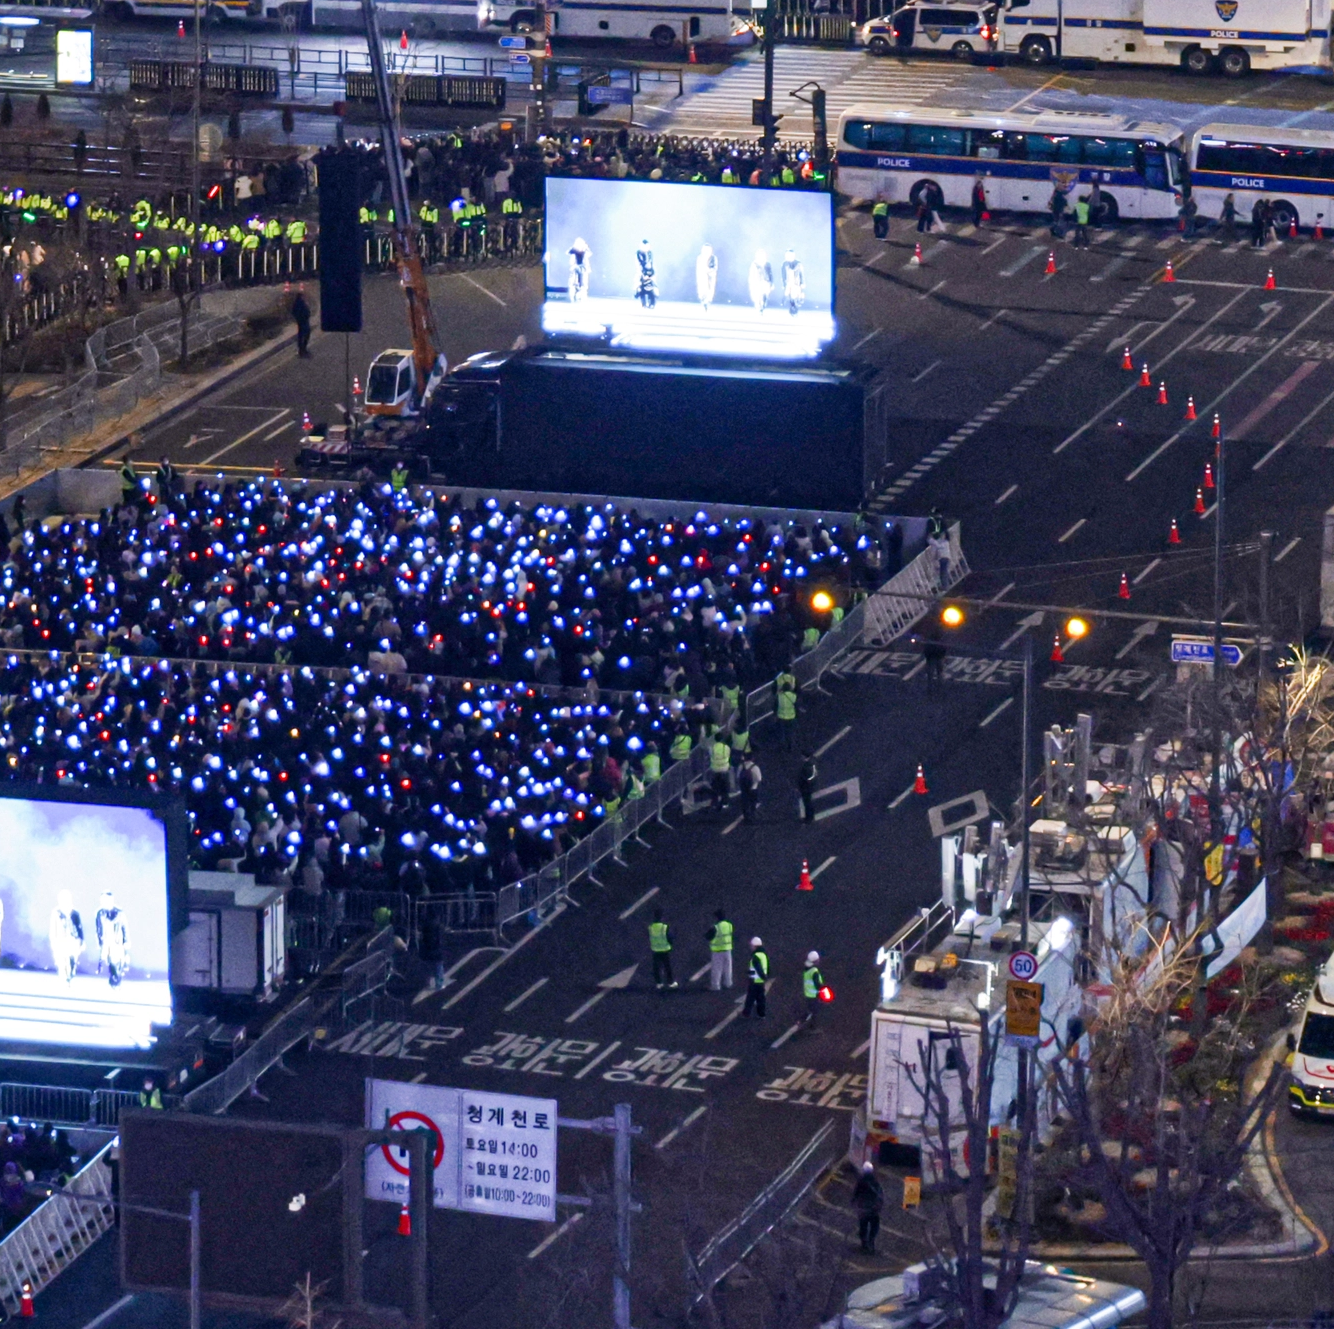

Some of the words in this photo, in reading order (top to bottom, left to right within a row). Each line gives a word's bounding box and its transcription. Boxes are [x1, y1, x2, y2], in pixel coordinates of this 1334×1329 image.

[1210, 30, 1239, 39] POLICE
[877, 157, 911, 168] POLICE
[1231, 177, 1265, 188] POLICE
[1014, 959, 1033, 973] 50
[467, 1104, 551, 1130] 청계천로
[465, 1138, 498, 1153] 토요일
[502, 1140, 538, 1158] 14:00
[513, 1165, 551, 1184] 22:00
